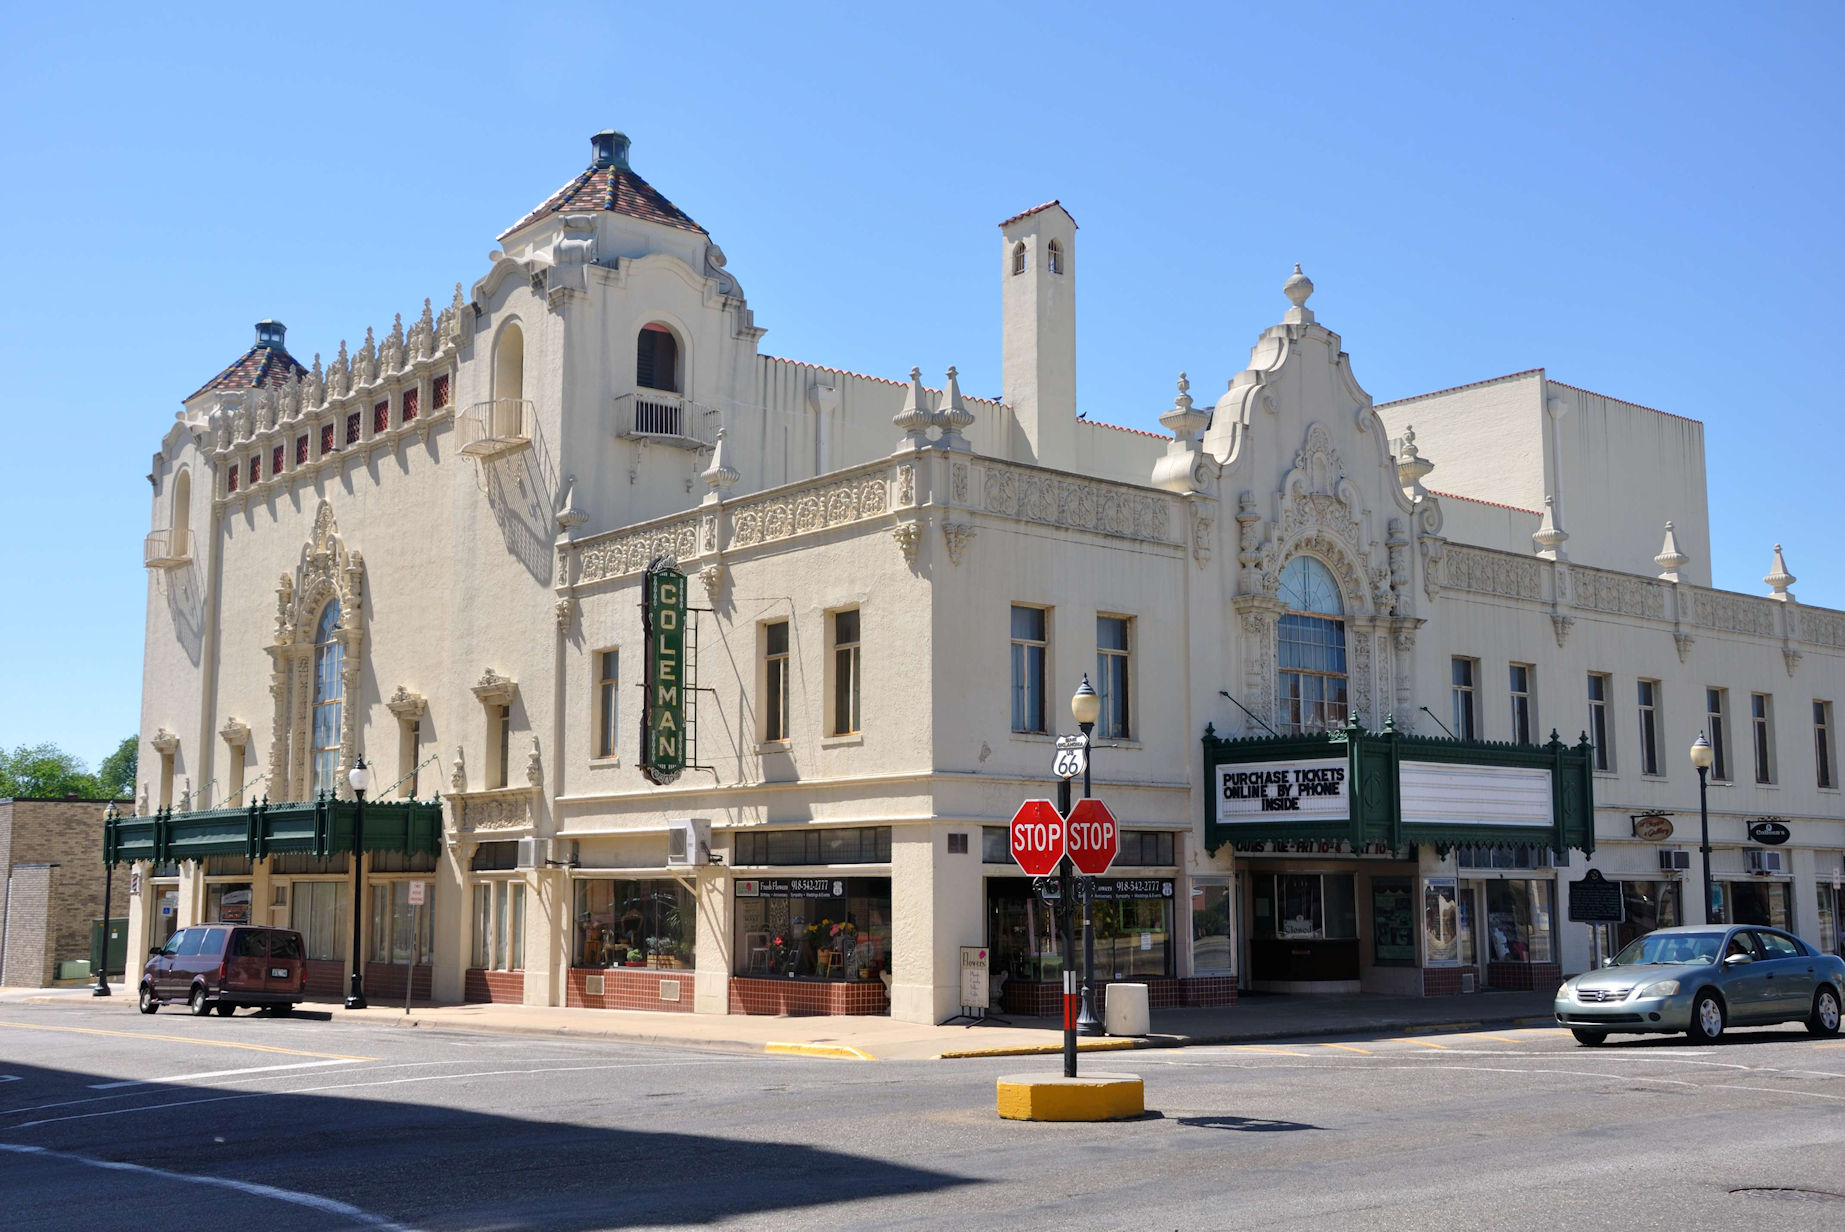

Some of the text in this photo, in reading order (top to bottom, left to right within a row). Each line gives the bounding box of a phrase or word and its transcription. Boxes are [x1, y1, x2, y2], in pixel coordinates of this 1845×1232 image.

[658, 583, 677, 758] COLEMAN
[1058, 754, 1078, 775] 66
[1223, 768, 1345, 786] PURCHASE TICKETS
[1223, 782, 1340, 799] ONLINE BY PHONE
[1261, 797, 1300, 811] INSIDE
[1014, 823, 1061, 851] STOP
[1069, 822, 1113, 850] STOP
[791, 879, 829, 890] 918-542-2777
[1116, 880, 1160, 891] 918-542-2777
